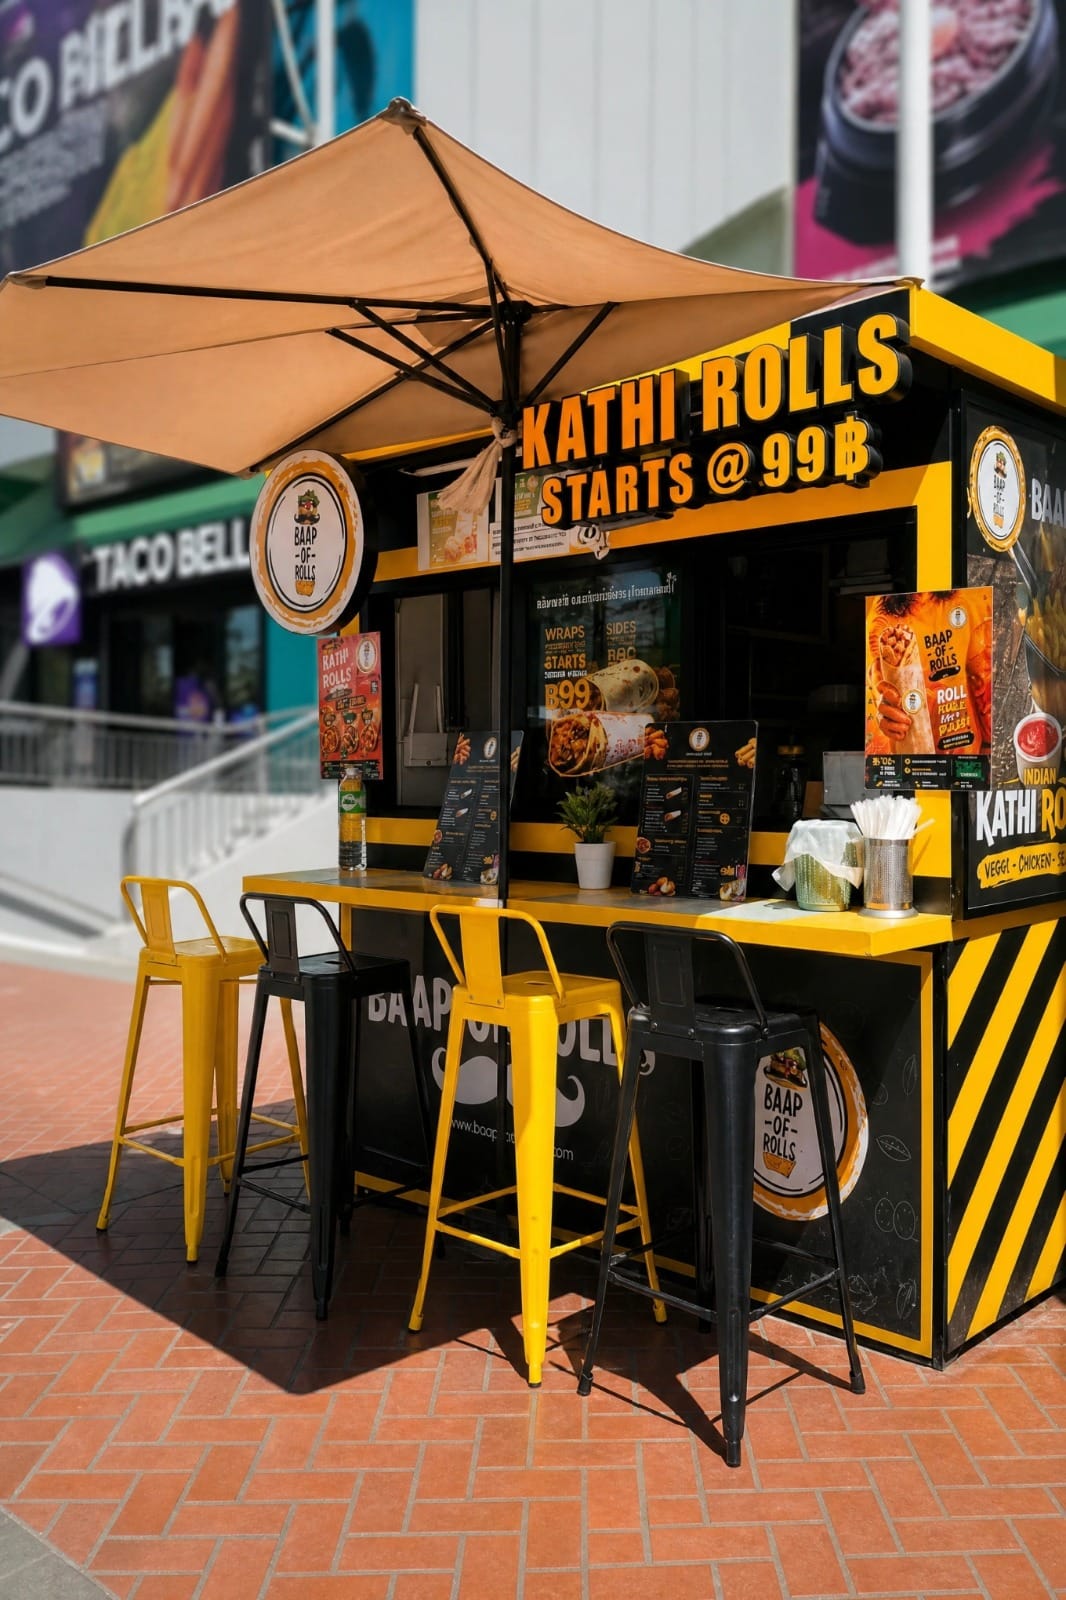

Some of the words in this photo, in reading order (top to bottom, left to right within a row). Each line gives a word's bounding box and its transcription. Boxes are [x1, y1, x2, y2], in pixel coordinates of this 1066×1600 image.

[522, 370, 677, 469] KATHI
[702, 312, 900, 432] ROLLS
[541, 453, 693, 526] STARTS
[706, 442, 751, 495] @
[294, 526, 317, 546] BAAP
[93, 531, 175, 593] TACO
[176, 518, 251, 578] BELL
[295, 565, 316, 581] ROLLS
[545, 625, 585, 641] WRAPS
[606, 620, 637, 635] SIDES
[924, 629, 953, 649] BAAP
[322, 648, 349, 671] KATHI
[930, 653, 958, 672] ROLLS
[323, 667, 352, 689] ROLLS
[937, 685, 967, 704] ROLL
[1023, 767, 1056, 786] INDIAN
[976, 789, 1036, 848] KATHI
[1018, 853, 1052, 873] CHICKEN
[764, 1083, 803, 1117] BAAP
[763, 1133, 796, 1161] ROLLS
